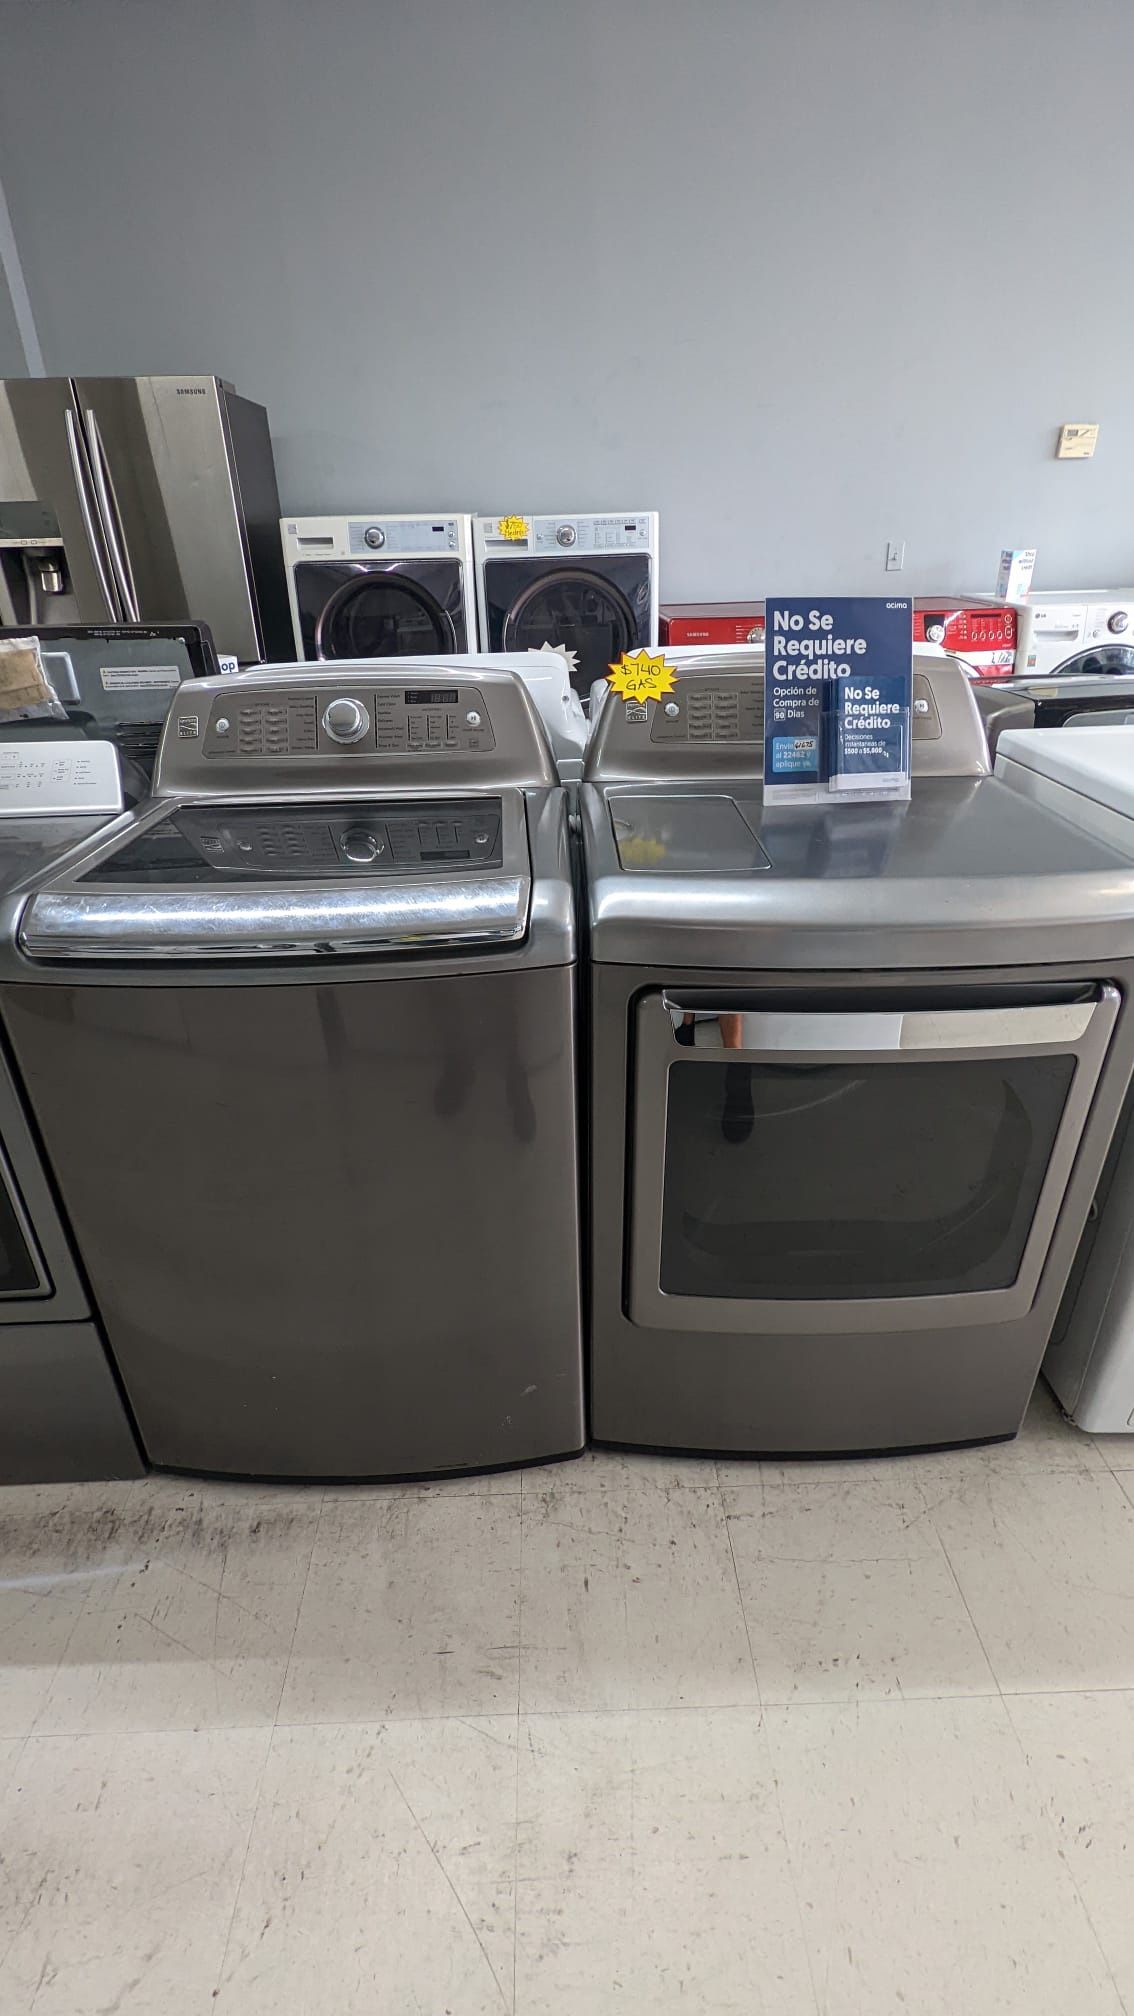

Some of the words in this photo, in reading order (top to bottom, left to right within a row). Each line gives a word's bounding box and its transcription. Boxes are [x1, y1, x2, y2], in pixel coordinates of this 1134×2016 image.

[886, 601, 908, 609] acima
[773, 610, 804, 631] No
[808, 609, 834, 631] Se
[773, 633, 867, 660] Requiere
[620, 663, 661, 676] $740
[772, 659, 851, 681] Crédito
[625, 677, 657, 691] GAS
[773, 686, 804, 697] Opción
[805, 686, 817, 695] de
[844, 686, 863, 700] No
[864, 686, 880, 700] Se
[773, 698, 806, 709] Compra
[808, 697, 820, 706] de
[844, 701, 900, 717] Requiere
[844, 715, 891, 729] Crédito
[844, 746, 859, 755] $500
